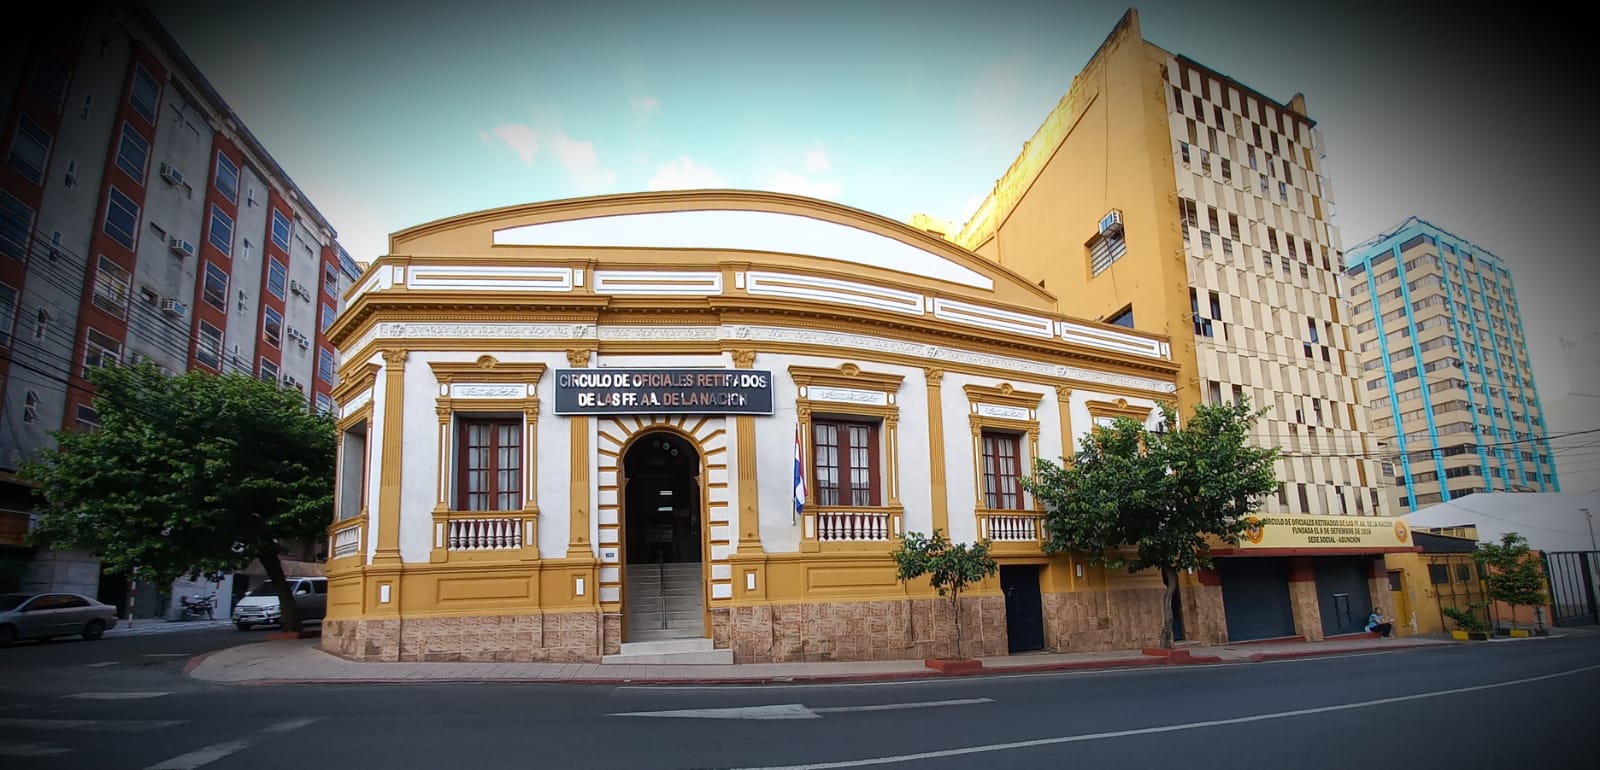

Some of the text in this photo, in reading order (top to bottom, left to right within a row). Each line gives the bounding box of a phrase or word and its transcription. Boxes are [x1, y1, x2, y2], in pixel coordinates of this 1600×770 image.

[559, 373, 767, 389] CIRCULO DE OFICIALES RETIRADOS
[578, 393, 595, 407] DE
[597, 393, 621, 407] LAS
[622, 393, 639, 406] FF.
[640, 392, 661, 406] AA.
[663, 393, 680, 406] DE
[681, 392, 698, 406] LA
[1285, 518, 1291, 526] DE
[1291, 518, 1314, 526] OFICIALES
[1292, 526, 1314, 535] FUNDADA
[1314, 526, 1320, 535] EL
[1324, 527, 1330, 535] DE
[1308, 535, 1320, 543] SEDE
[1320, 535, 1336, 544] SOCIAL
